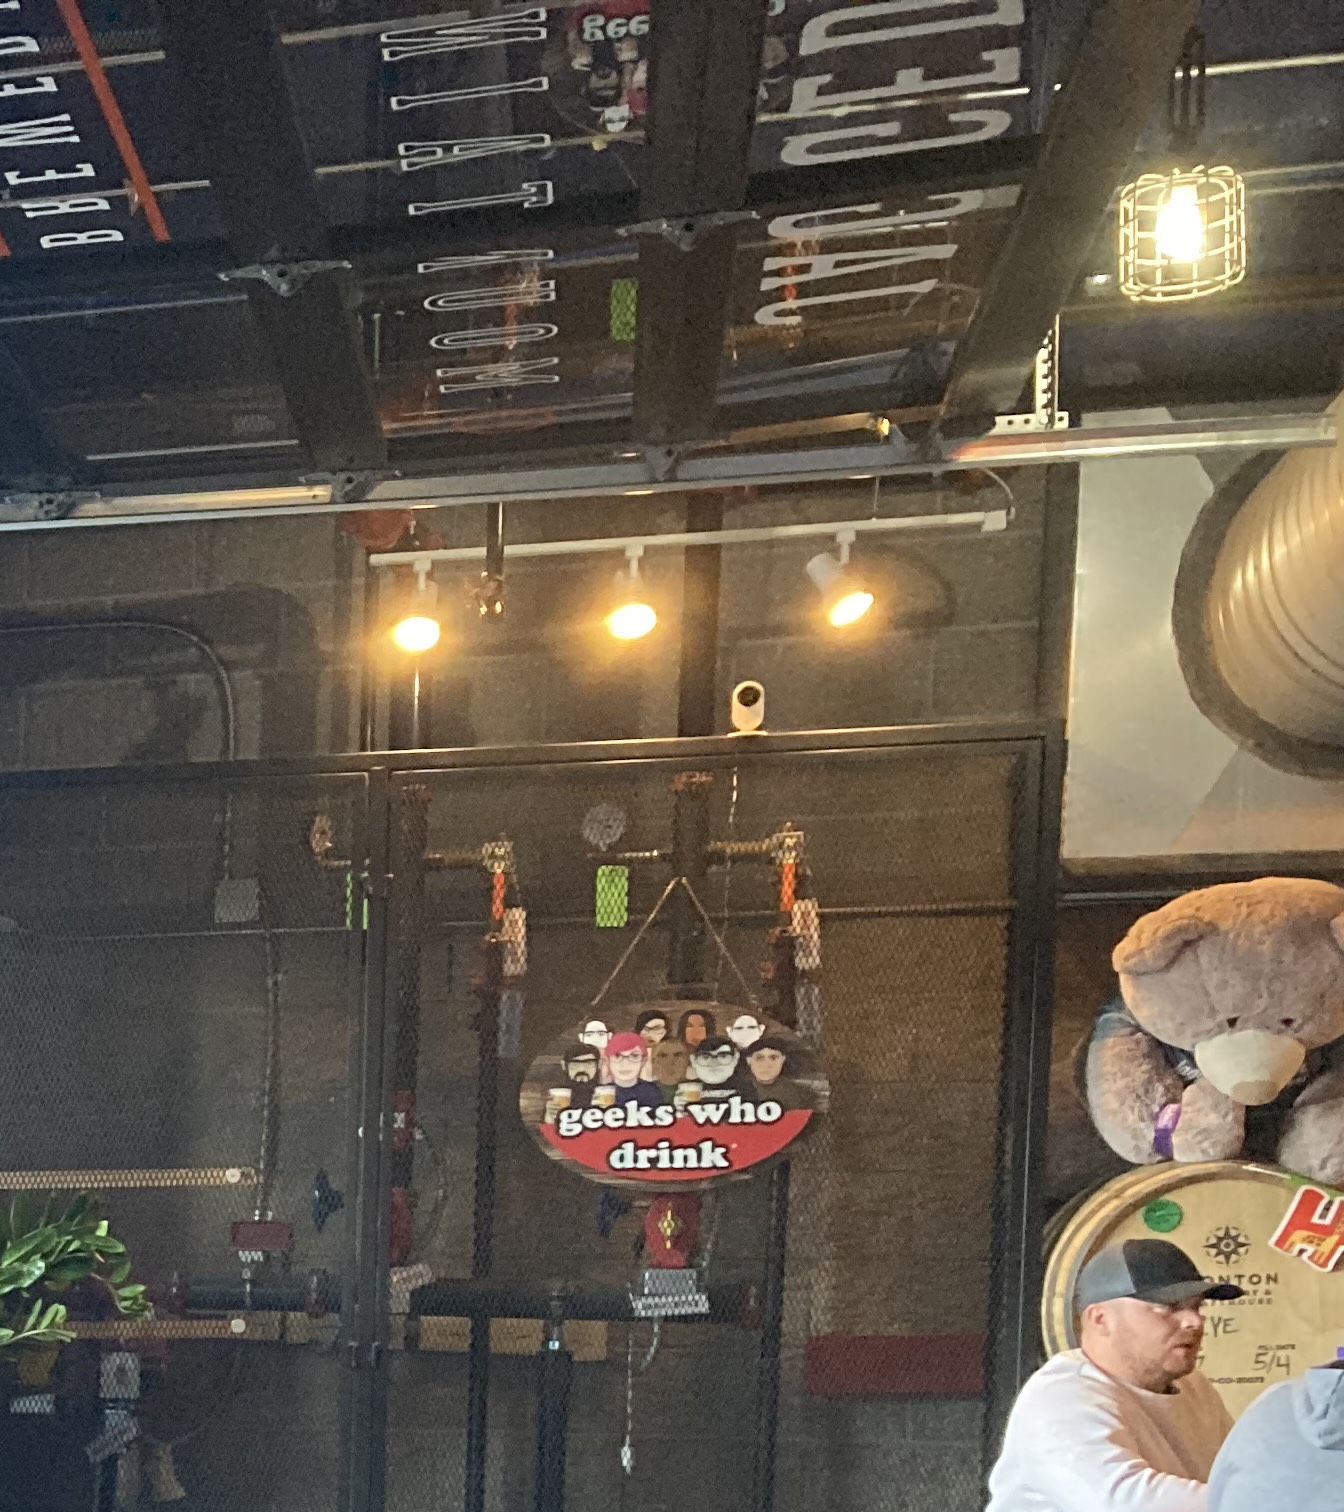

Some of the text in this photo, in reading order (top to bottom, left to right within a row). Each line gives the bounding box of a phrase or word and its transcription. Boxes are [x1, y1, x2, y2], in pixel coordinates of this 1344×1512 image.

[559, 1096, 782, 1136] geeks who
[609, 1141, 730, 1169] drink
[1251, 1352, 1291, 1376] 5/4
